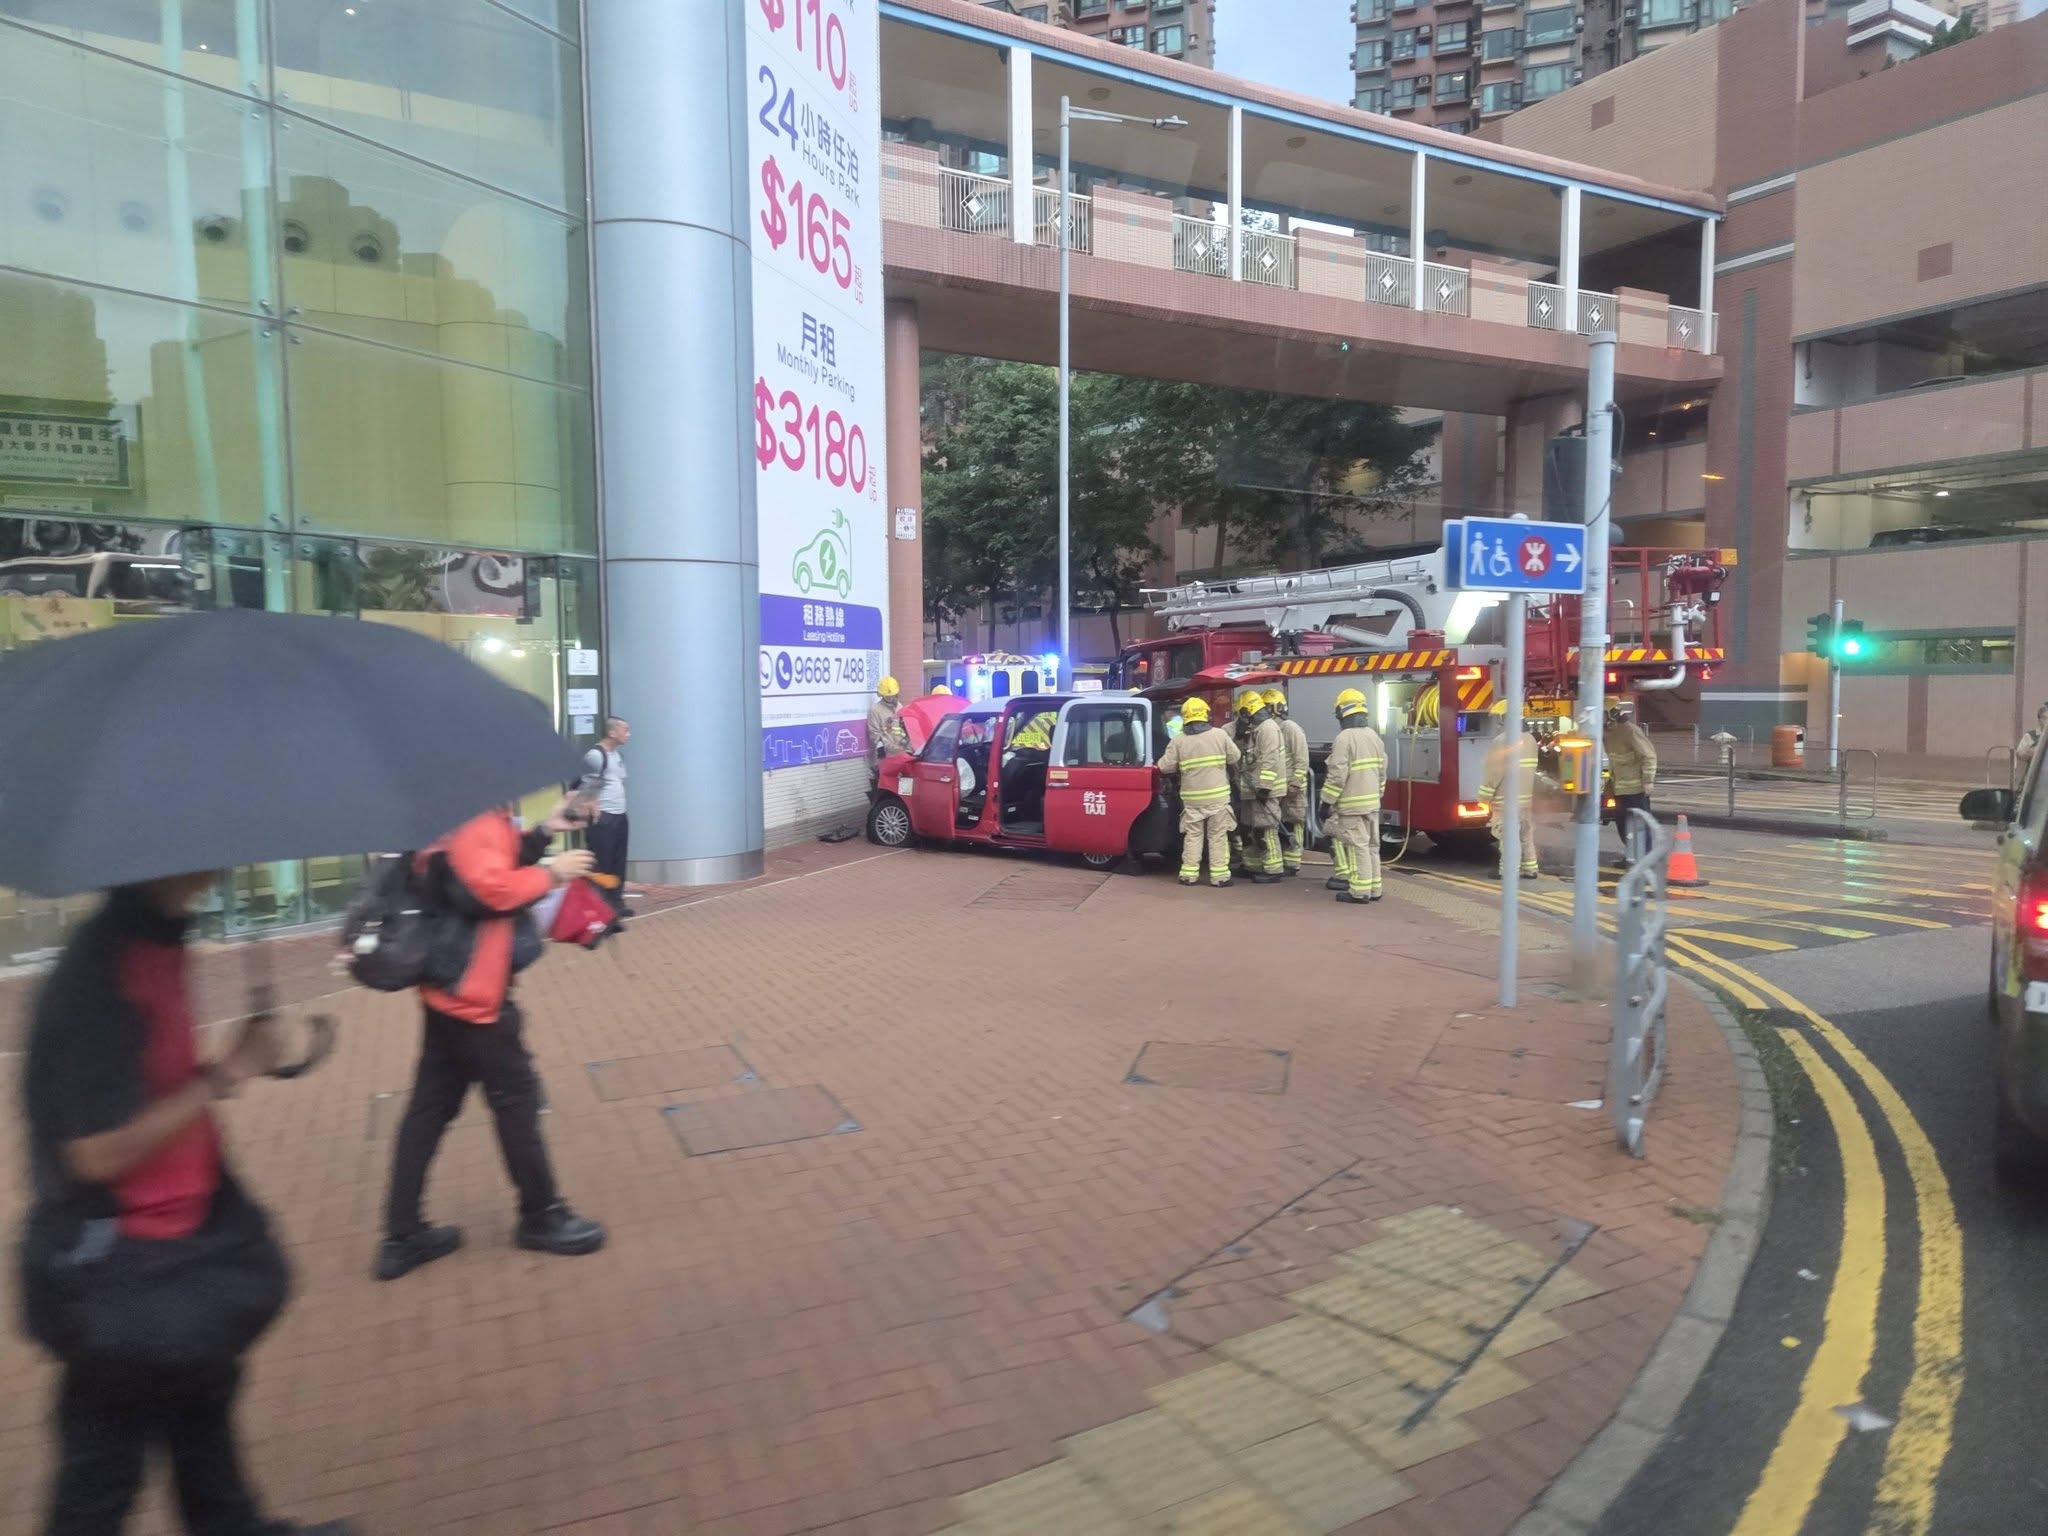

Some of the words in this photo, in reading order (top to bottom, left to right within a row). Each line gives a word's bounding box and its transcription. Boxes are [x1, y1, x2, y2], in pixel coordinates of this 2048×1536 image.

[759, 65, 799, 152] 24
[802, 139, 835, 186] Hours
[839, 172, 860, 208] Park
[761, 154, 852, 290] $165
[802, 311, 836, 368] 月租
[777, 343, 819, 384] Monthly
[821, 365, 855, 403] Parking
[755, 376, 867, 494] $3180
[794, 655, 831, 684] 9668
[835, 657, 864, 684] 7488
[1083, 790, 1107, 803] 的士
[1083, 802, 1107, 816] TAXI
